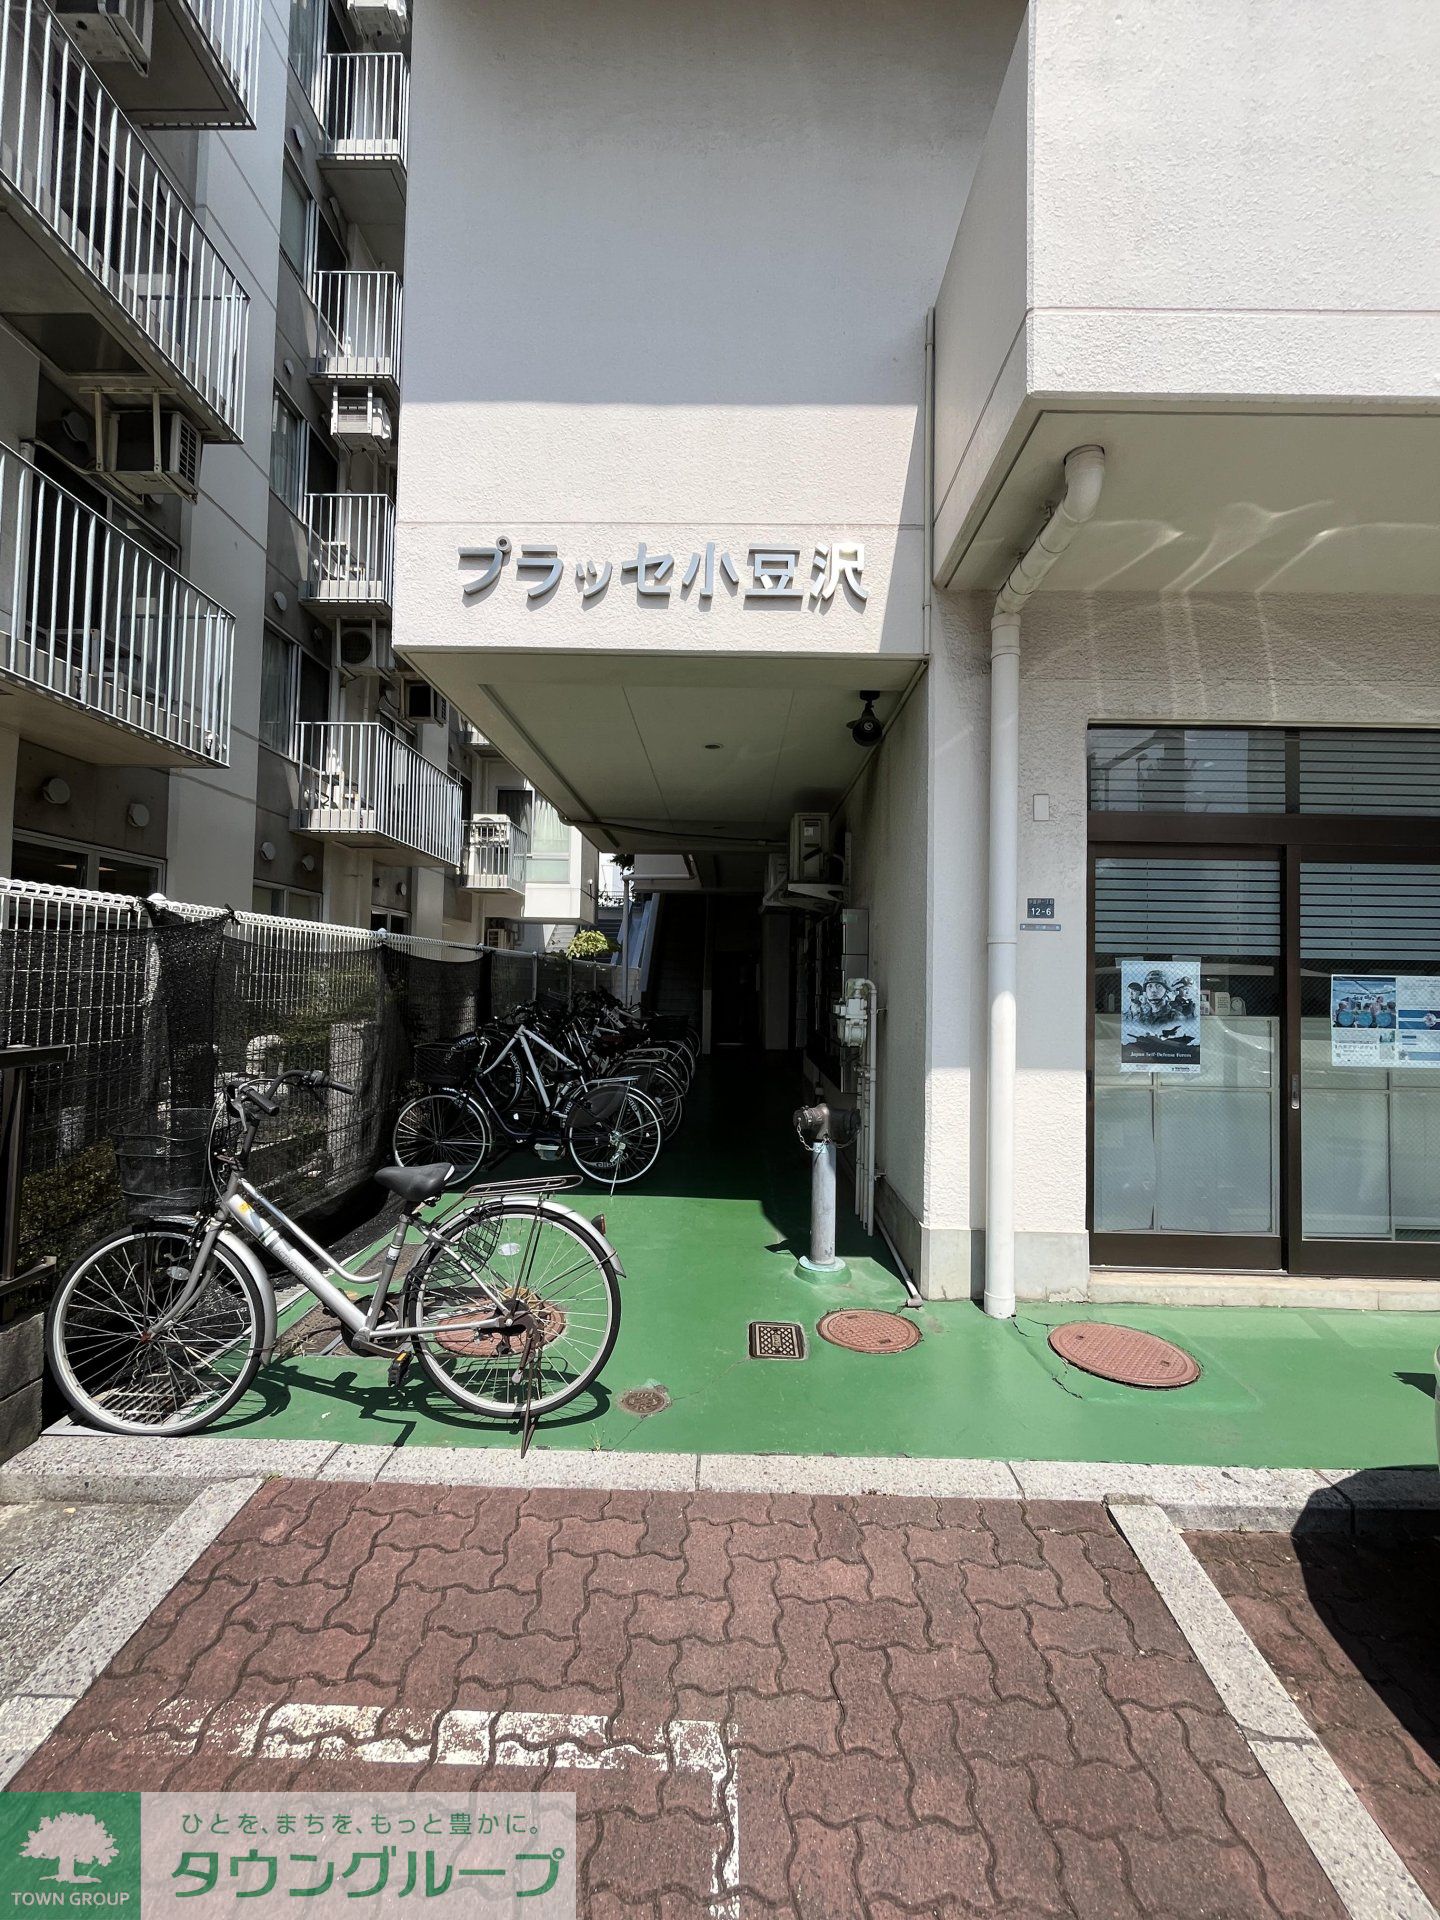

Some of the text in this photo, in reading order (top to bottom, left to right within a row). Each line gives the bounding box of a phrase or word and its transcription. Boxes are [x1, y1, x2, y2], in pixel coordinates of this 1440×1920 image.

[458, 535, 869, 602] プラッセ小豆沢
[1031, 907, 1052, 916] 12-6
